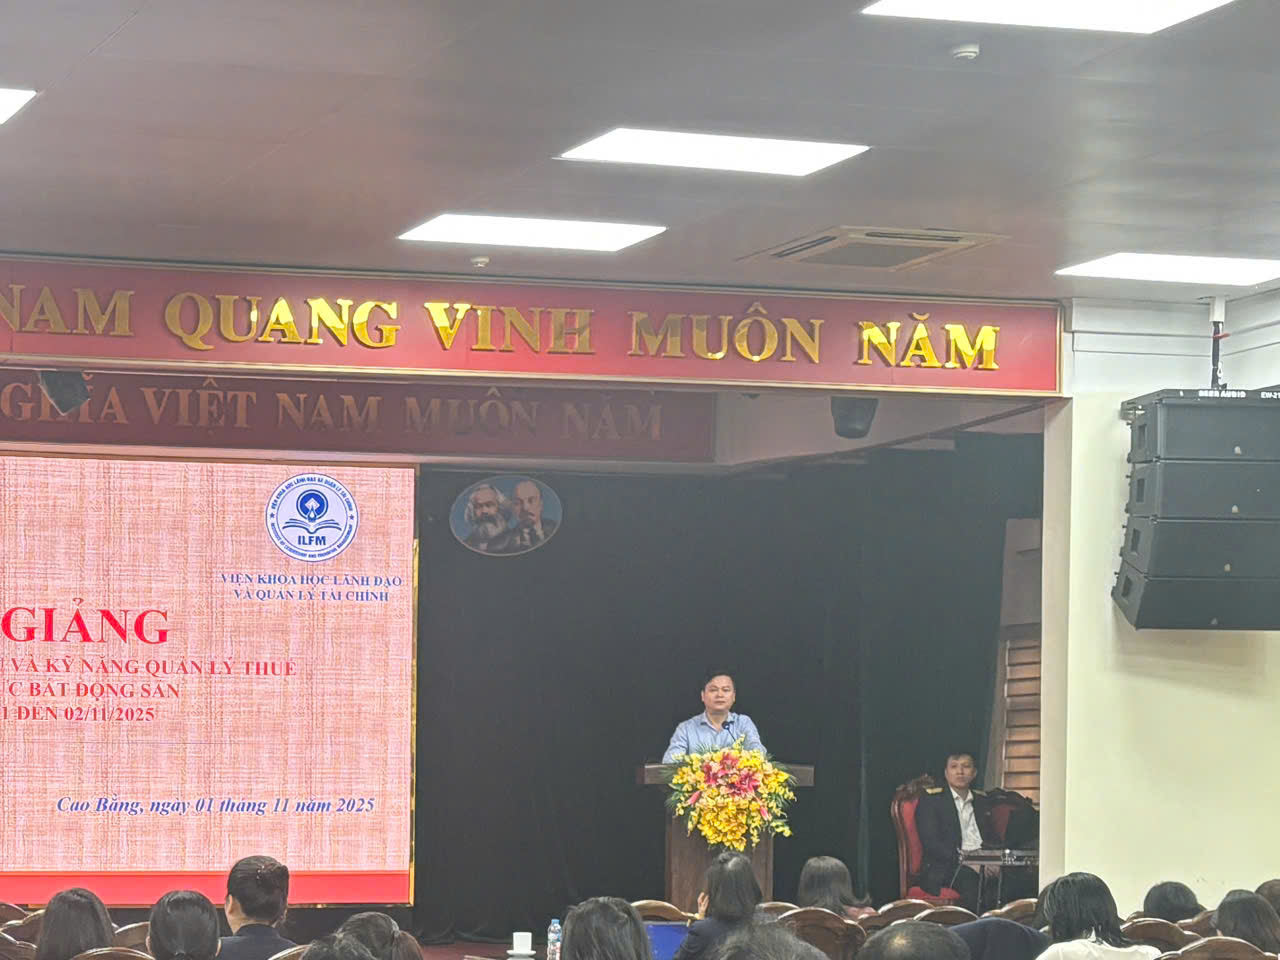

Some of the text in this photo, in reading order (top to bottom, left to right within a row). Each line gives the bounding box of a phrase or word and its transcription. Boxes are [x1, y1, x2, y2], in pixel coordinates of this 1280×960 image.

[164, 291, 402, 351] QUANG
[423, 301, 597, 355] VINH
[626, 301, 825, 364] MUÔN
[856, 311, 1001, 371] NĂM
[139, 377, 257, 437] VIỆT
[275, 392, 384, 433] NAM
[297, 535, 327, 546] ILFM
[220, 572, 402, 588] VIỆN KHOA HỌC LÃNH ĐẠO
[234, 587, 252, 600] VÀ
[345, 589, 389, 601] CHÍNH
[1, 597, 170, 644] GIẢNG
[11, 654, 39, 673] VÀ
[46, 655, 74, 673] KỸ
[81, 656, 139, 675] NĂNG
[210, 657, 236, 675] LÝ
[76, 680, 135, 701] ĐỘNG
[64, 706, 155, 722] 02/11/2025
[57, 794, 375, 816] Cao Bằng, ngày 01 tháng 11 năm 2025
